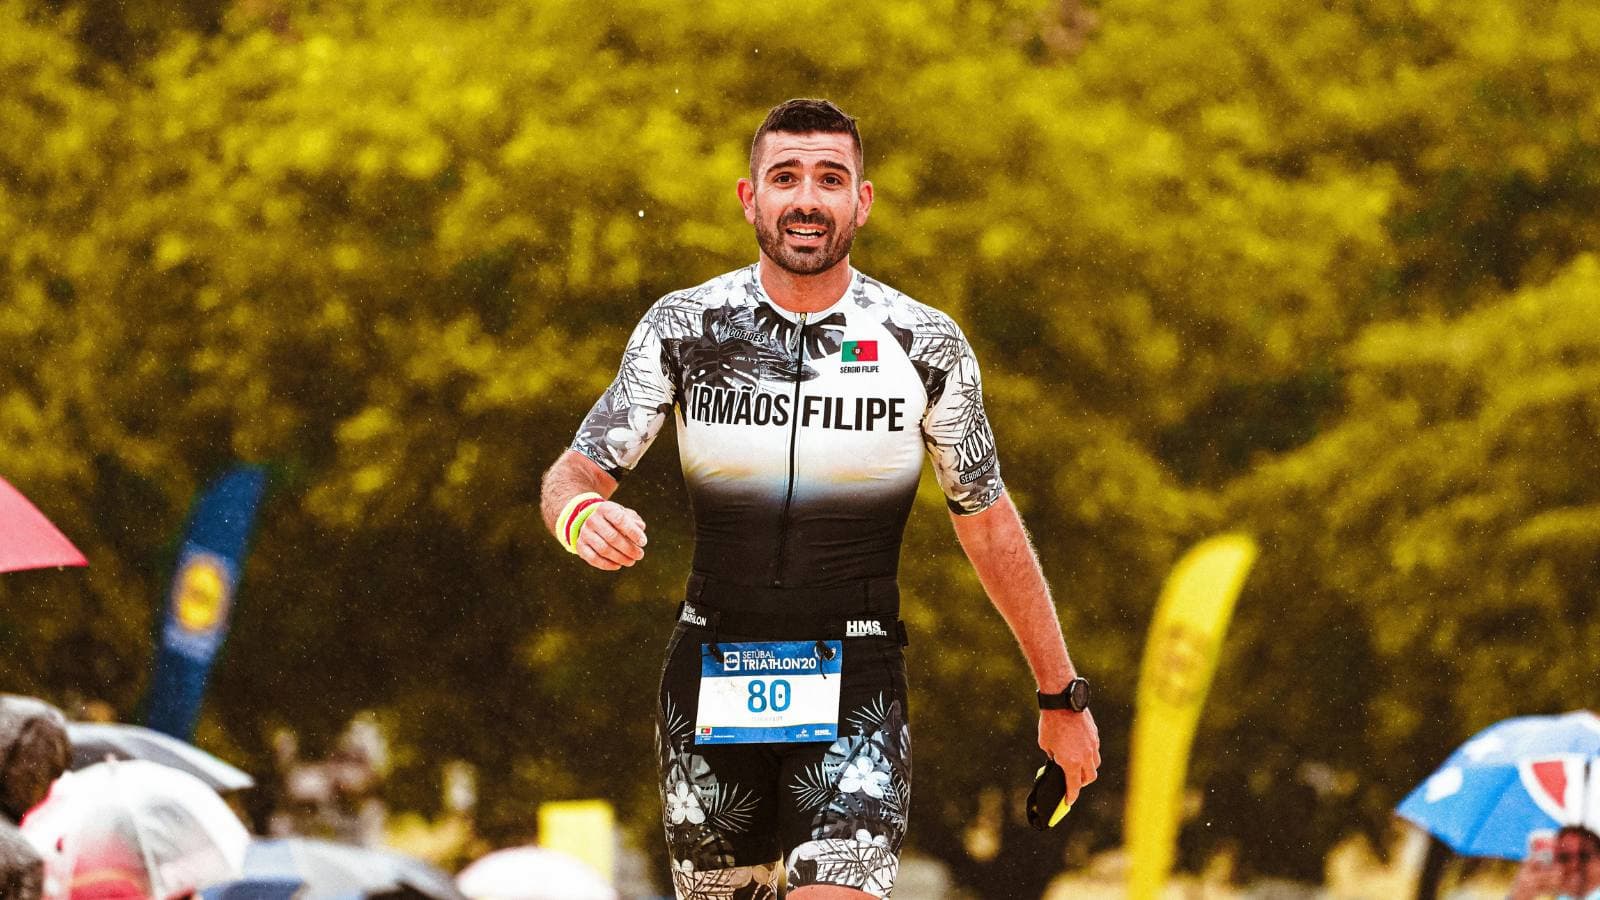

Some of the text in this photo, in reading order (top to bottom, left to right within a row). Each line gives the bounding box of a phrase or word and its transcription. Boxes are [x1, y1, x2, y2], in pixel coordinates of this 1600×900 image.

[862, 365, 880, 373] FILIPE
[690, 385, 906, 432] IRMÃOS FILIPE
[846, 620, 882, 633] HMS
[742, 649, 776, 659] SETÚBAL
[747, 679, 791, 713] 80
